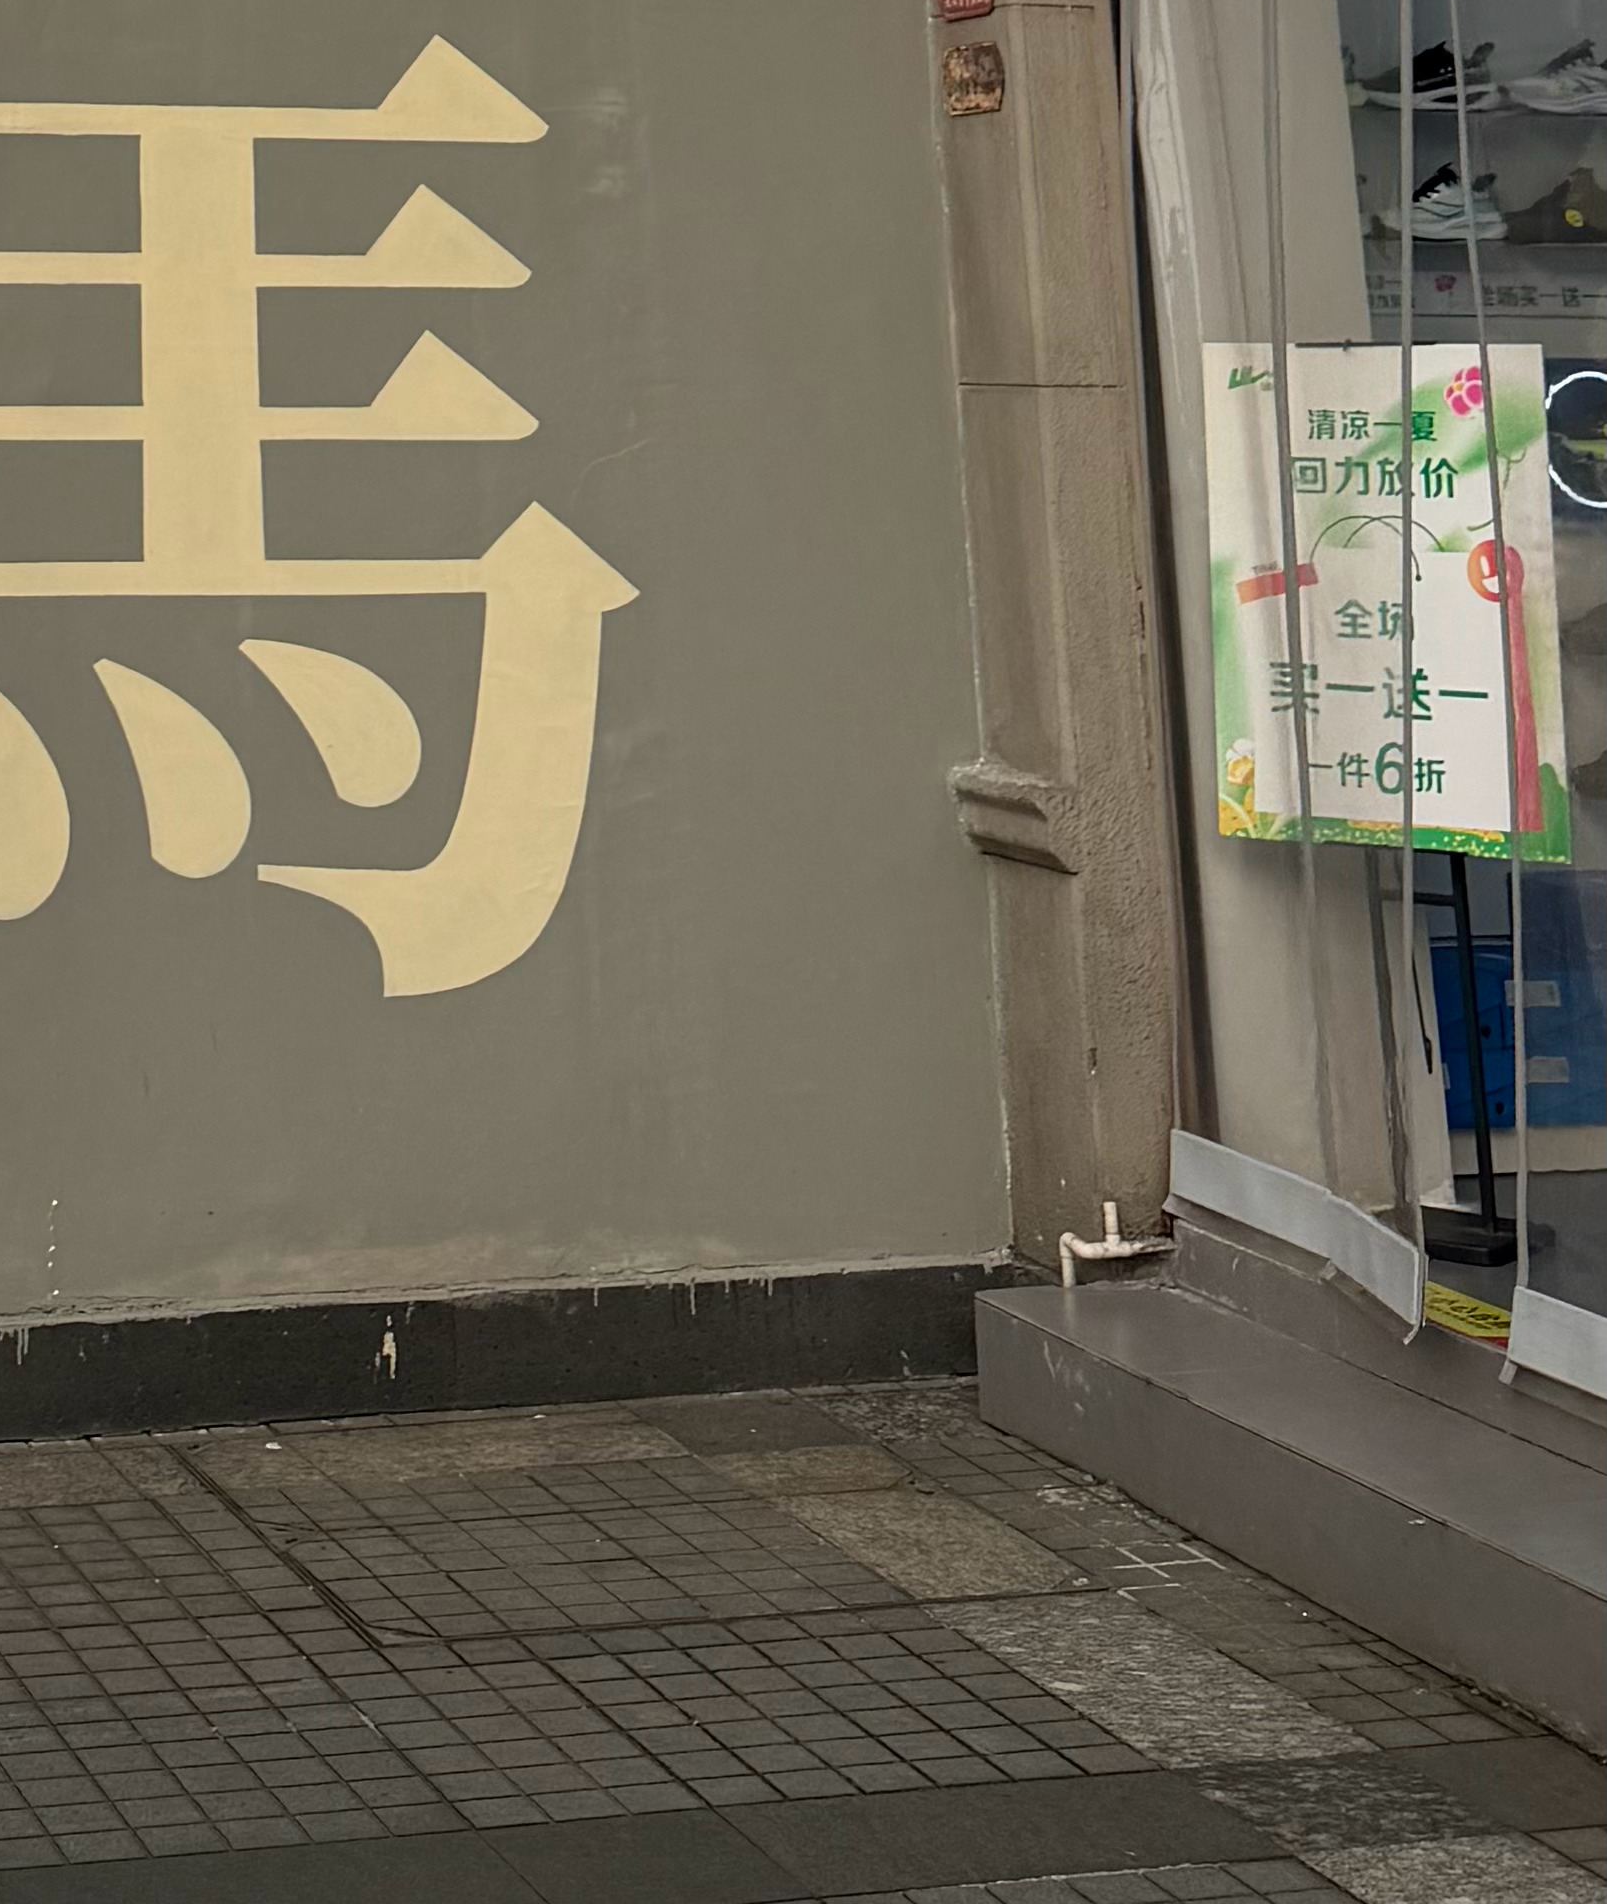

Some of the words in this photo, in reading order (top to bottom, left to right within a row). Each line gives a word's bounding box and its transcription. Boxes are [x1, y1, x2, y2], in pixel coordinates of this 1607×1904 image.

[1307, 408, 1438, 442] 清凉一夏
[1290, 456, 1459, 499] 回力放价
[1269, 661, 1489, 721] 买一送一
[1308, 741, 1447, 795] 一件6折
